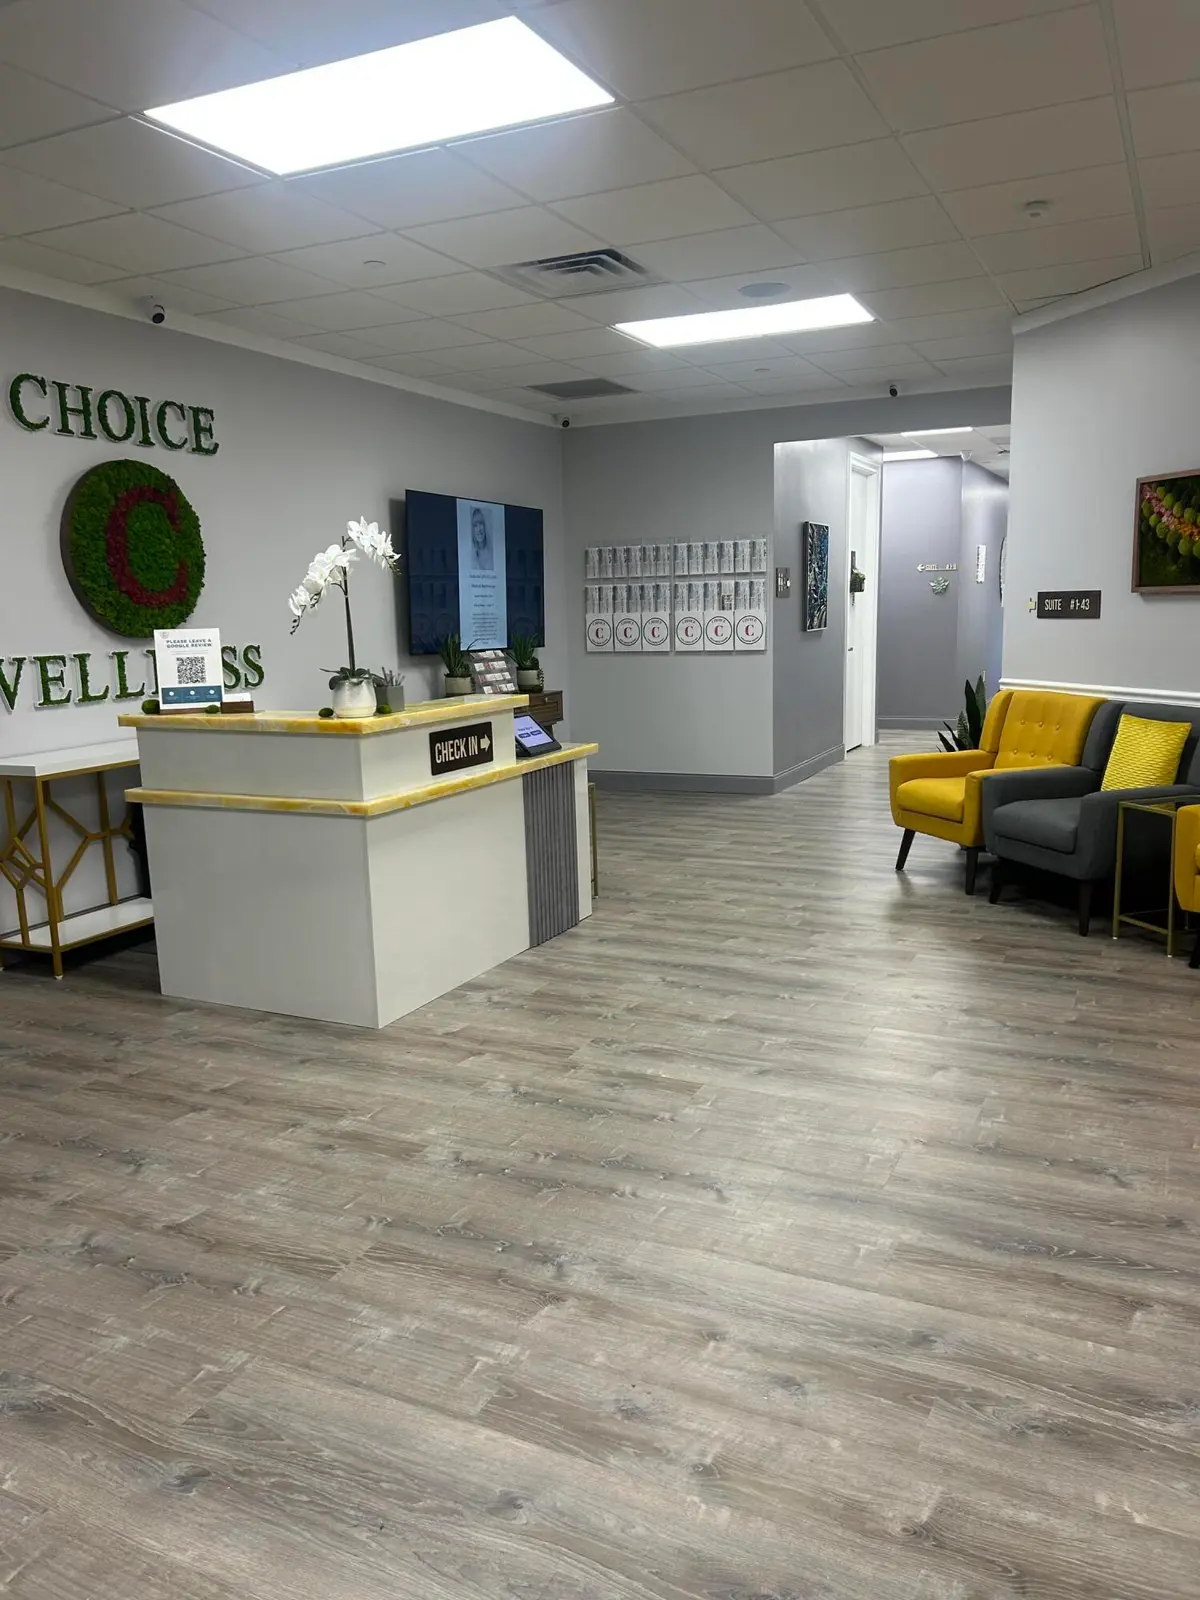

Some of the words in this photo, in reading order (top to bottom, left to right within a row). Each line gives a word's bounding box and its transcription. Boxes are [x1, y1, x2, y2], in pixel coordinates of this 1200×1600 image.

[9, 373, 219, 455] CHOICE
[105, 484, 188, 608] C
[1044, 598, 1062, 611] SUITE
[595, 627, 604, 639] C
[623, 626, 632, 639] C
[651, 626, 660, 638] C
[684, 625, 694, 637] C
[714, 625, 724, 637] C
[744, 624, 754, 636] C
[435, 738, 467, 764] CHECK
[468, 735, 478, 756] IN
